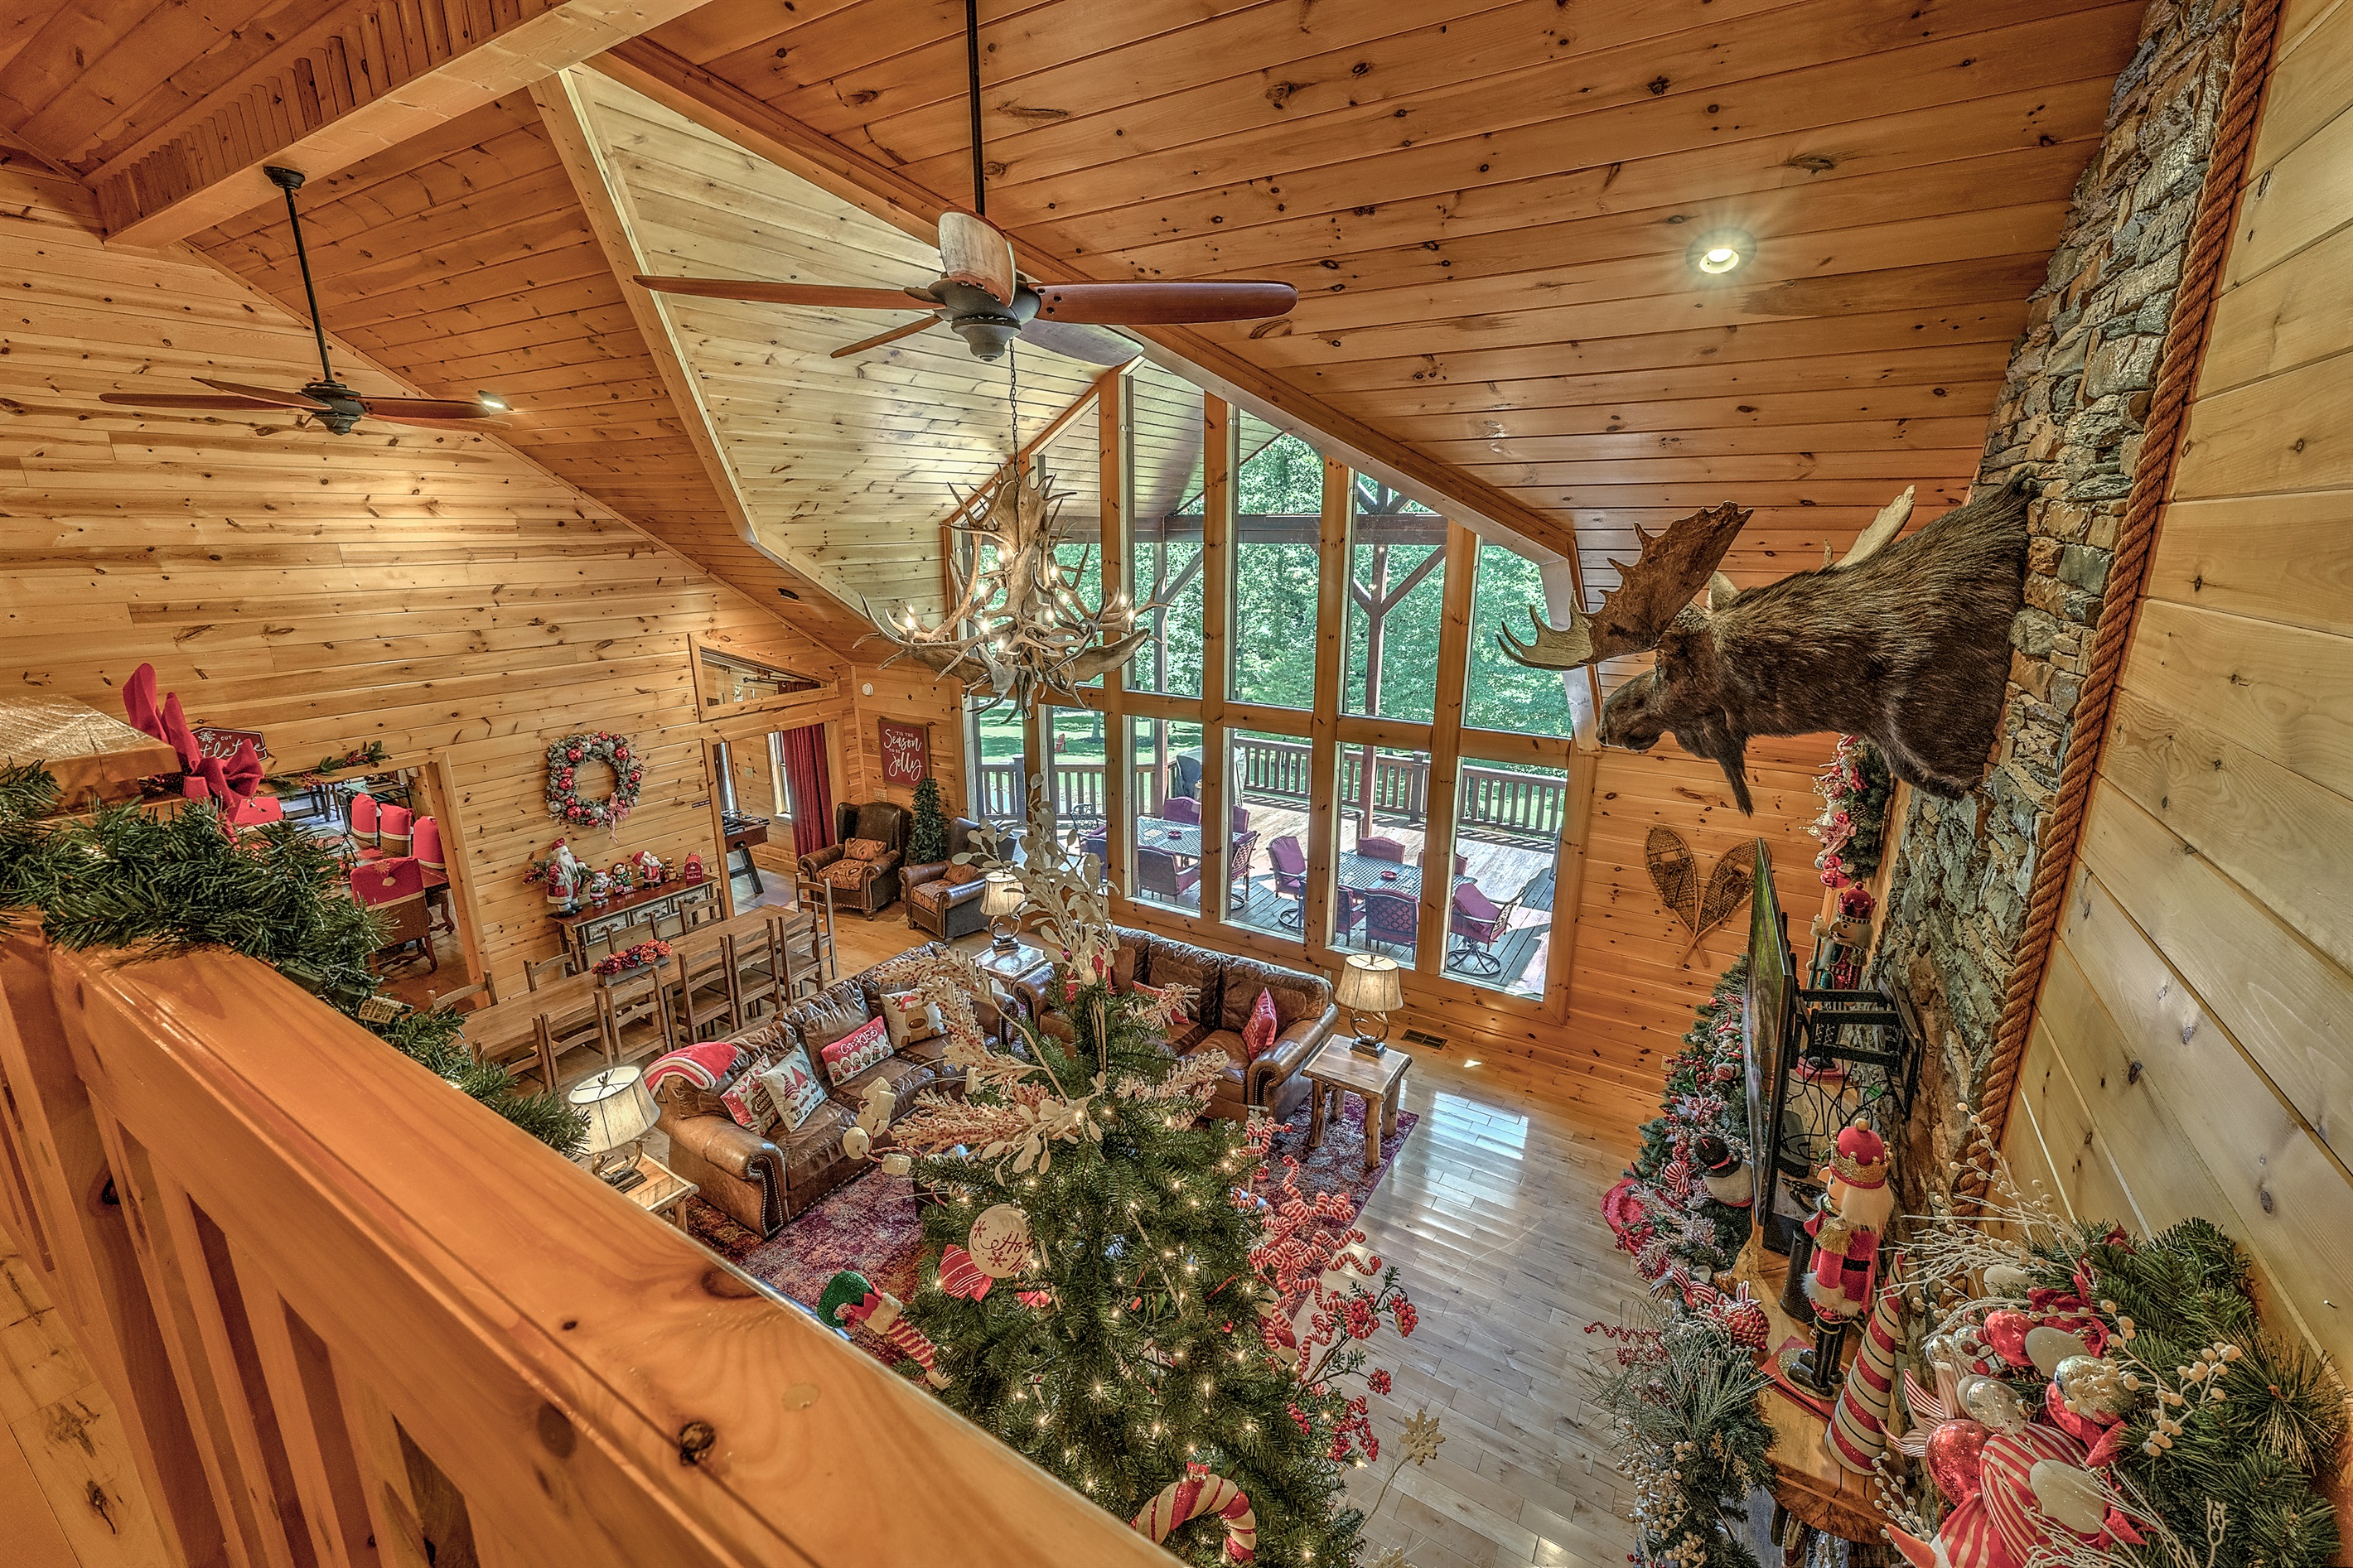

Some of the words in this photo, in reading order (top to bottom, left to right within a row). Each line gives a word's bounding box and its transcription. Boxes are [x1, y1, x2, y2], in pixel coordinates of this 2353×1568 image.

[200, 738, 266, 760] tlete
[883, 728, 922, 752] Season
[888, 751, 923, 781] jolly
[840, 1025, 878, 1054] COOKIES
[756, 1090, 769, 1105] MERR
